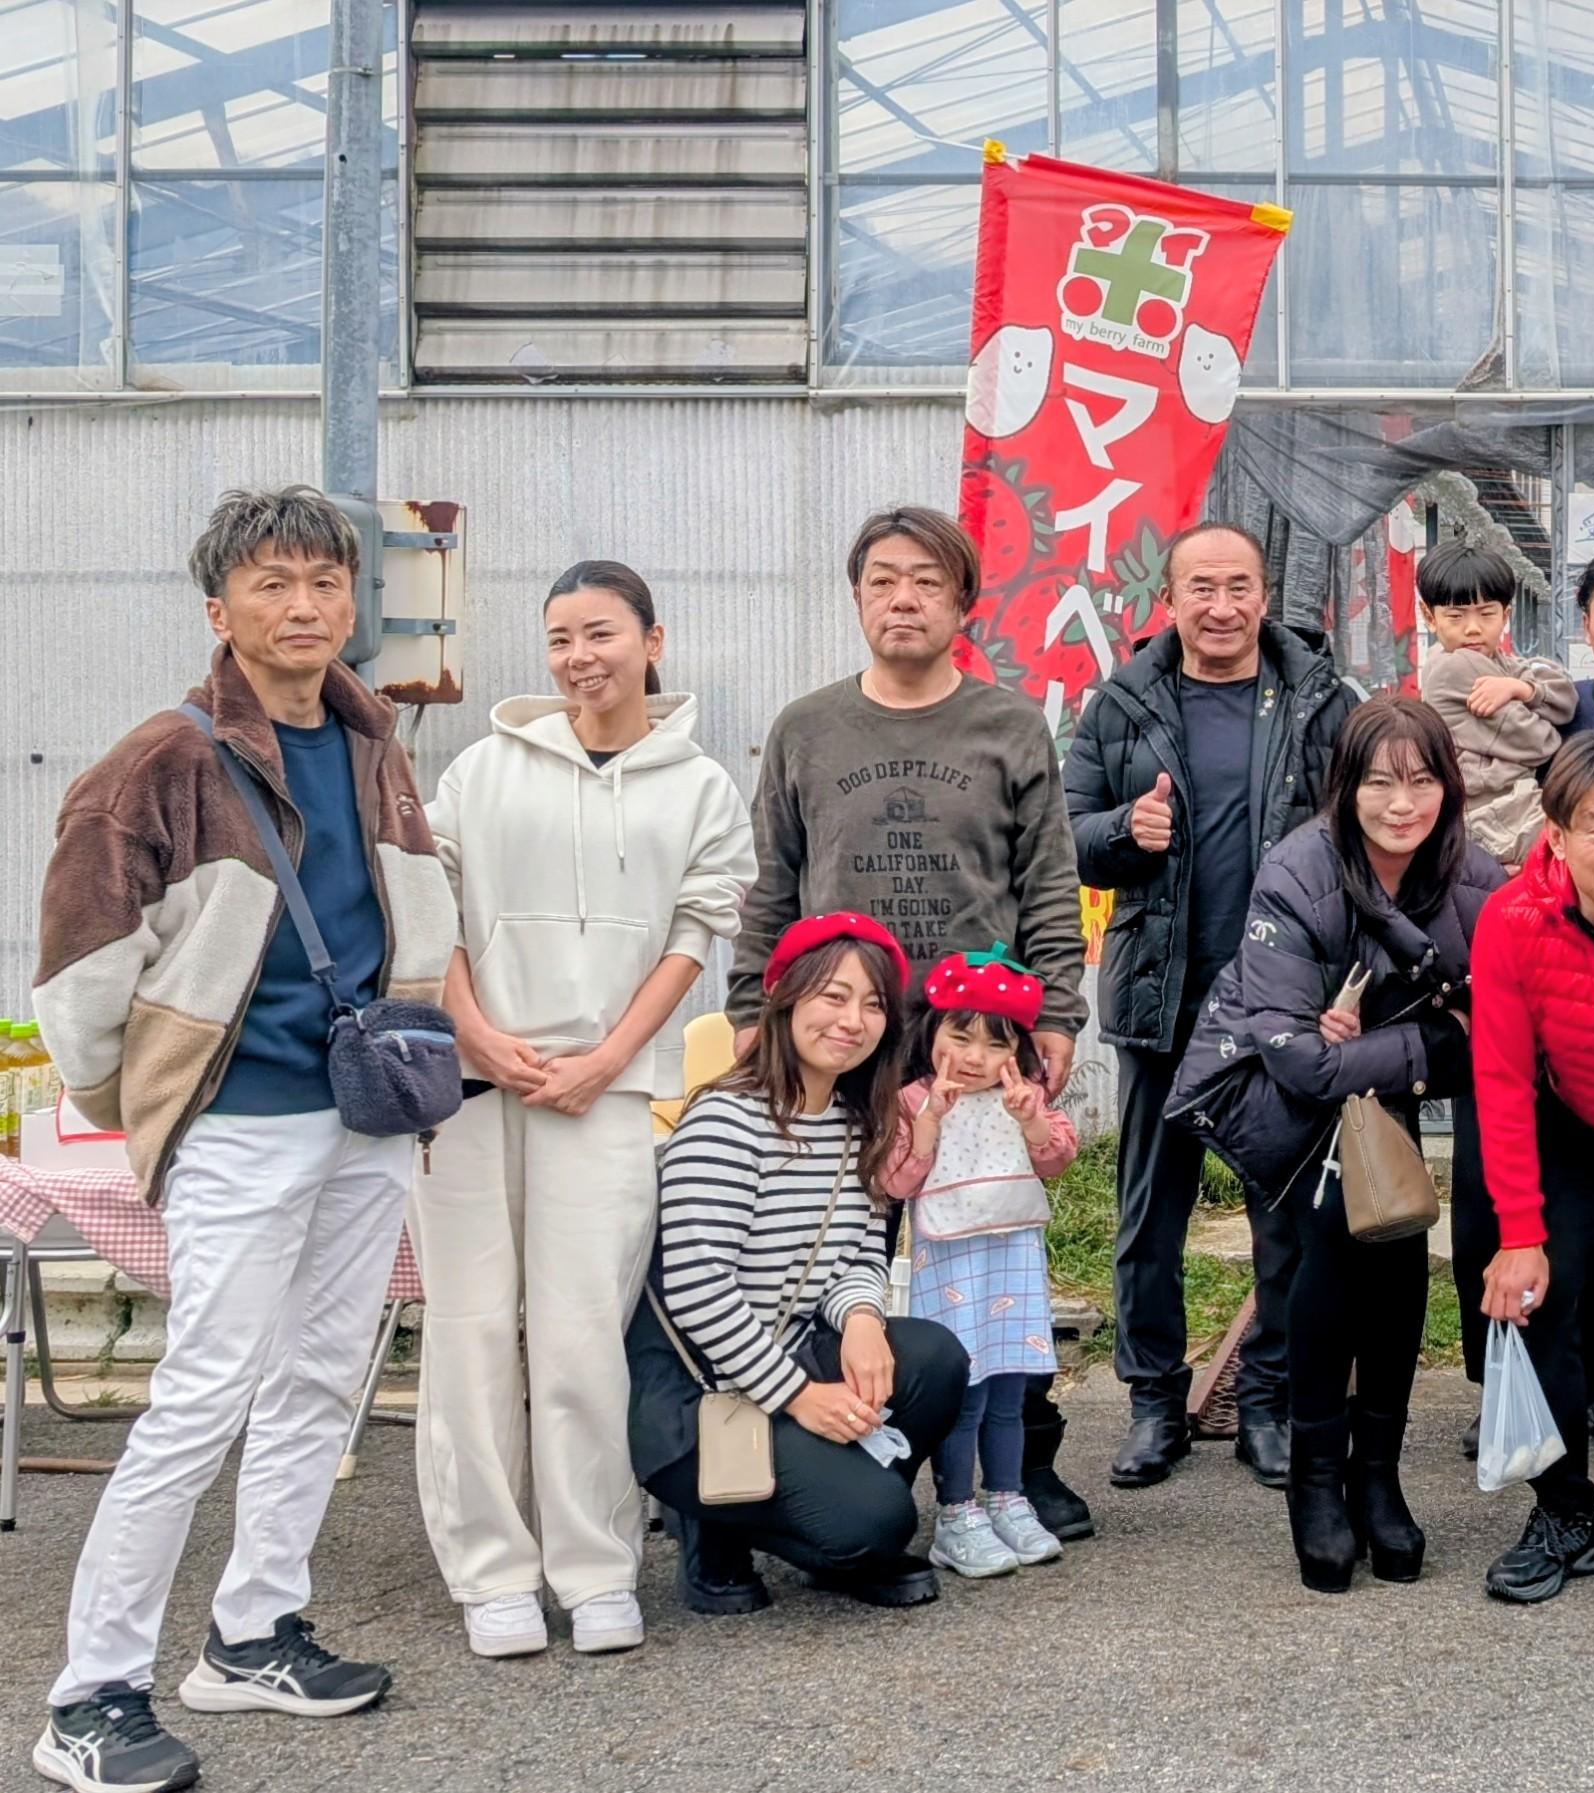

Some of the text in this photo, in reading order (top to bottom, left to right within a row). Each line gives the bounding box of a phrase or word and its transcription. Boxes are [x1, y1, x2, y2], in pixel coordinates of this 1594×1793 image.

[1065, 318, 1165, 354] my berry farm
[836, 767, 872, 795] DOG
[887, 832, 922, 850] ONE
[854, 853, 960, 873] CALIFORNIA
[893, 877, 928, 894] DAY.
[870, 899, 951, 917] I'M GOING
[901, 920, 947, 938] TAKE
